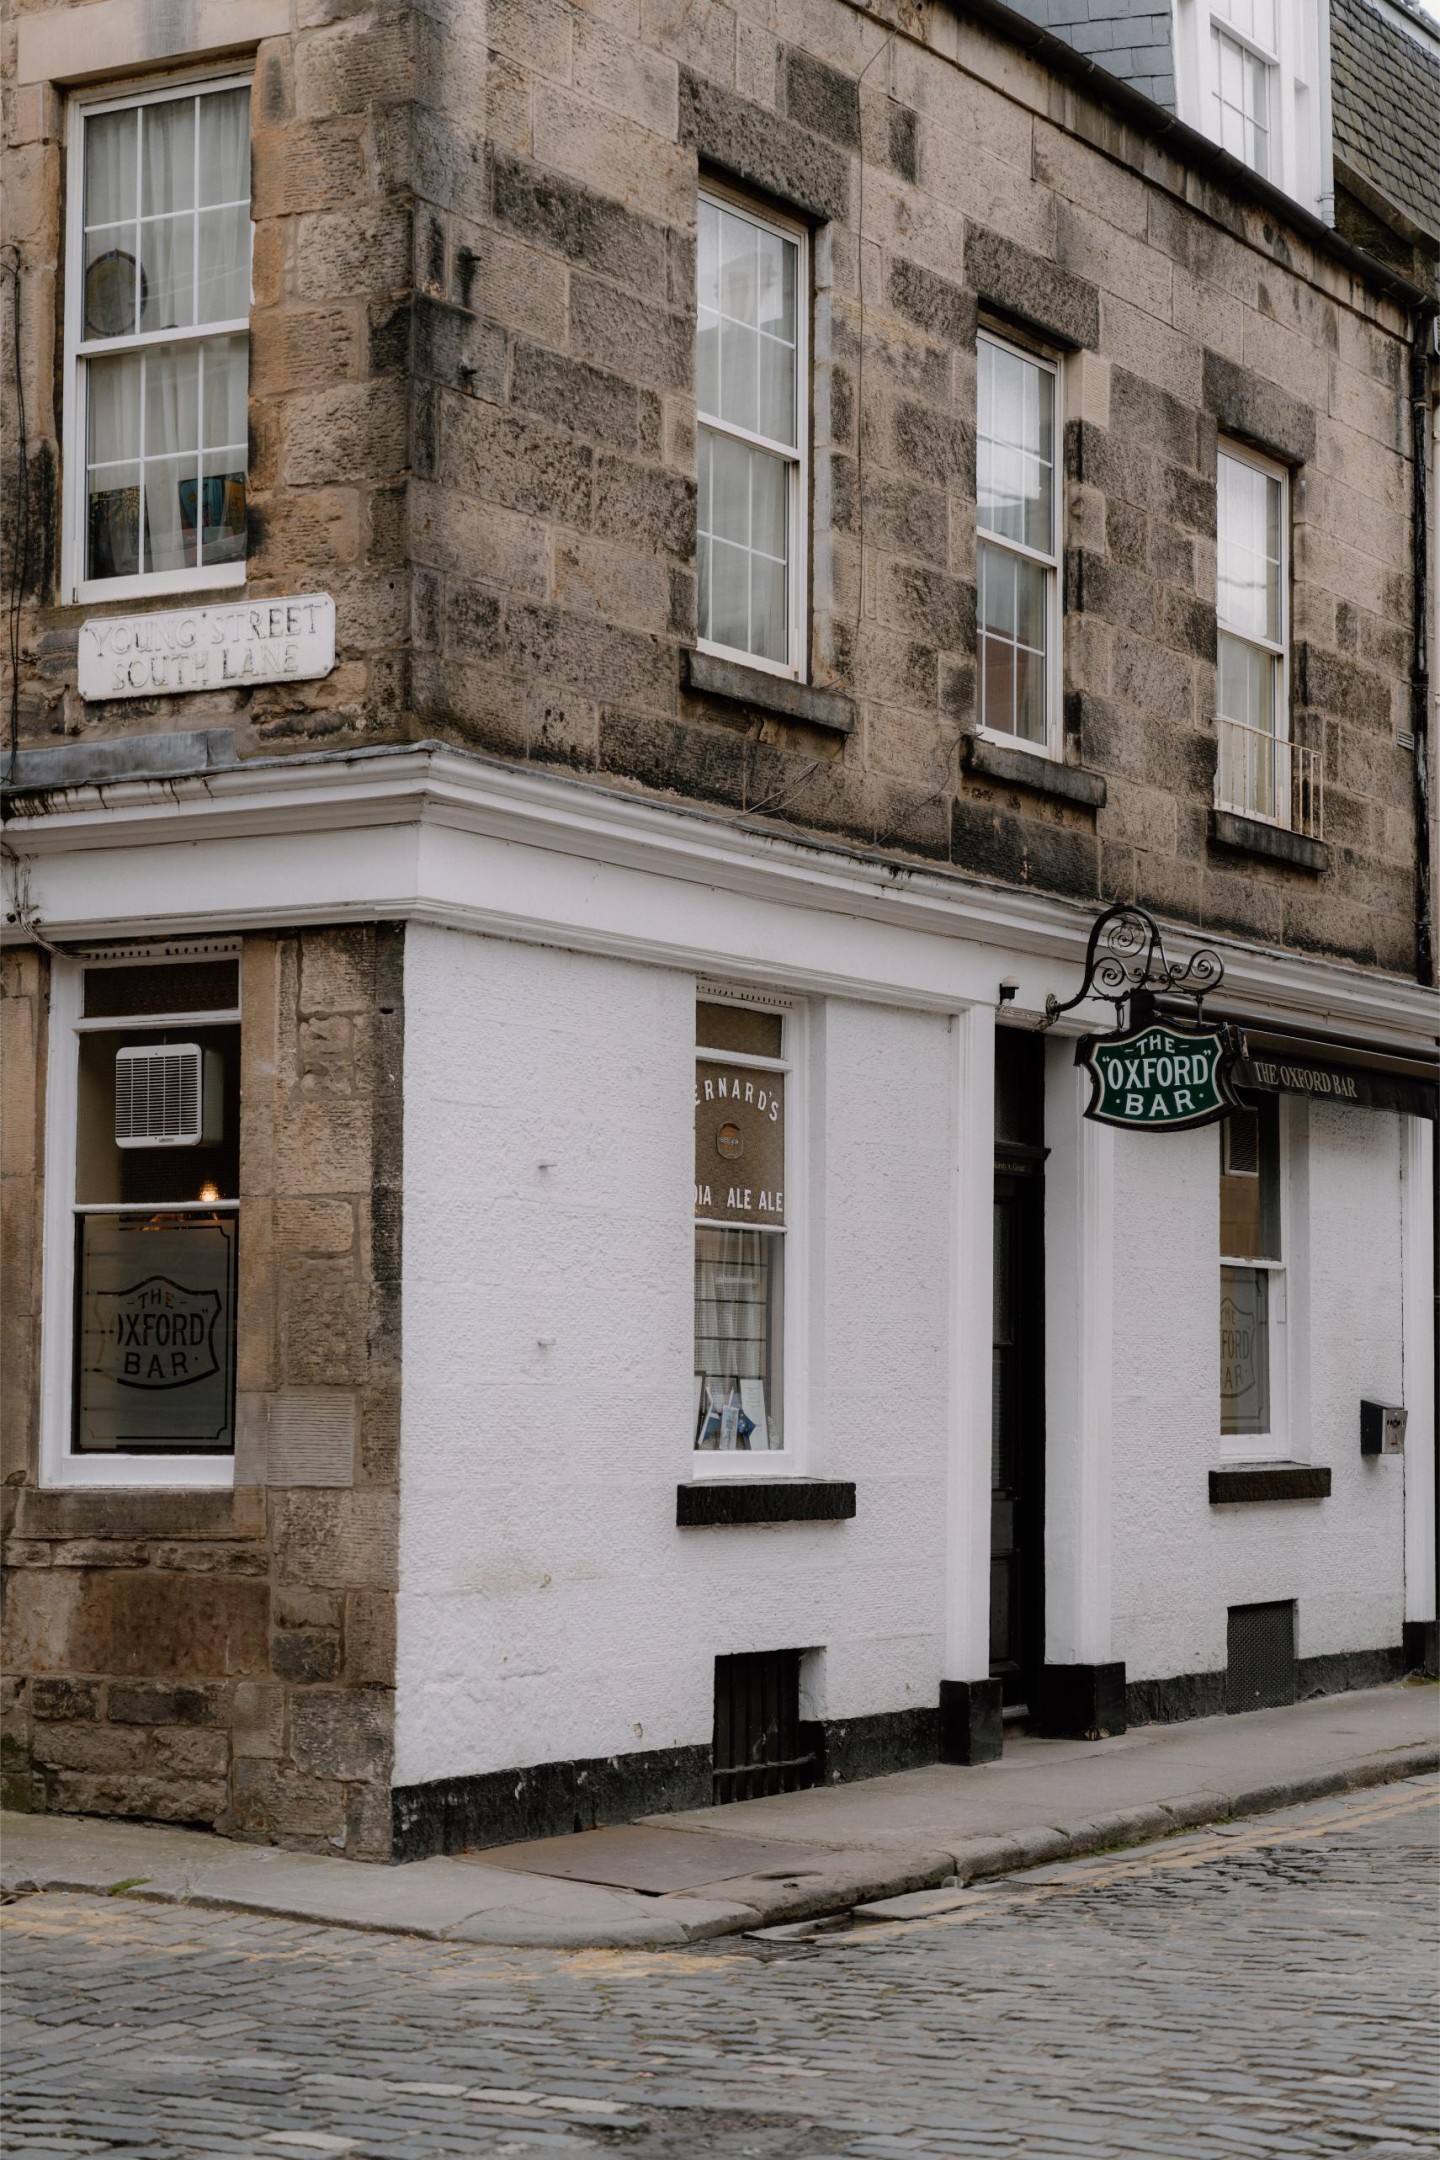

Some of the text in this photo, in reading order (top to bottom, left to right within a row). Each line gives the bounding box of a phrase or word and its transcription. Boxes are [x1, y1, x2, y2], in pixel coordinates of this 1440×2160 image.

[88, 604, 325, 657] YOUNG STREET
[112, 642, 300, 691] SOUTH LANE
[1136, 1034, 1175, 1056] THE
[1102, 1049, 1211, 1090] “OXFORD”
[1253, 1061, 1358, 1098] THE OXFORD BAR
[1124, 1089, 1196, 1117] BAR
[727, 1187, 752, 1210] ALE
[758, 1190, 783, 1212] ALE
[138, 1288, 175, 1309] THE
[123, 1351, 189, 1379] BAR
[1220, 1364, 1244, 1389] AR
